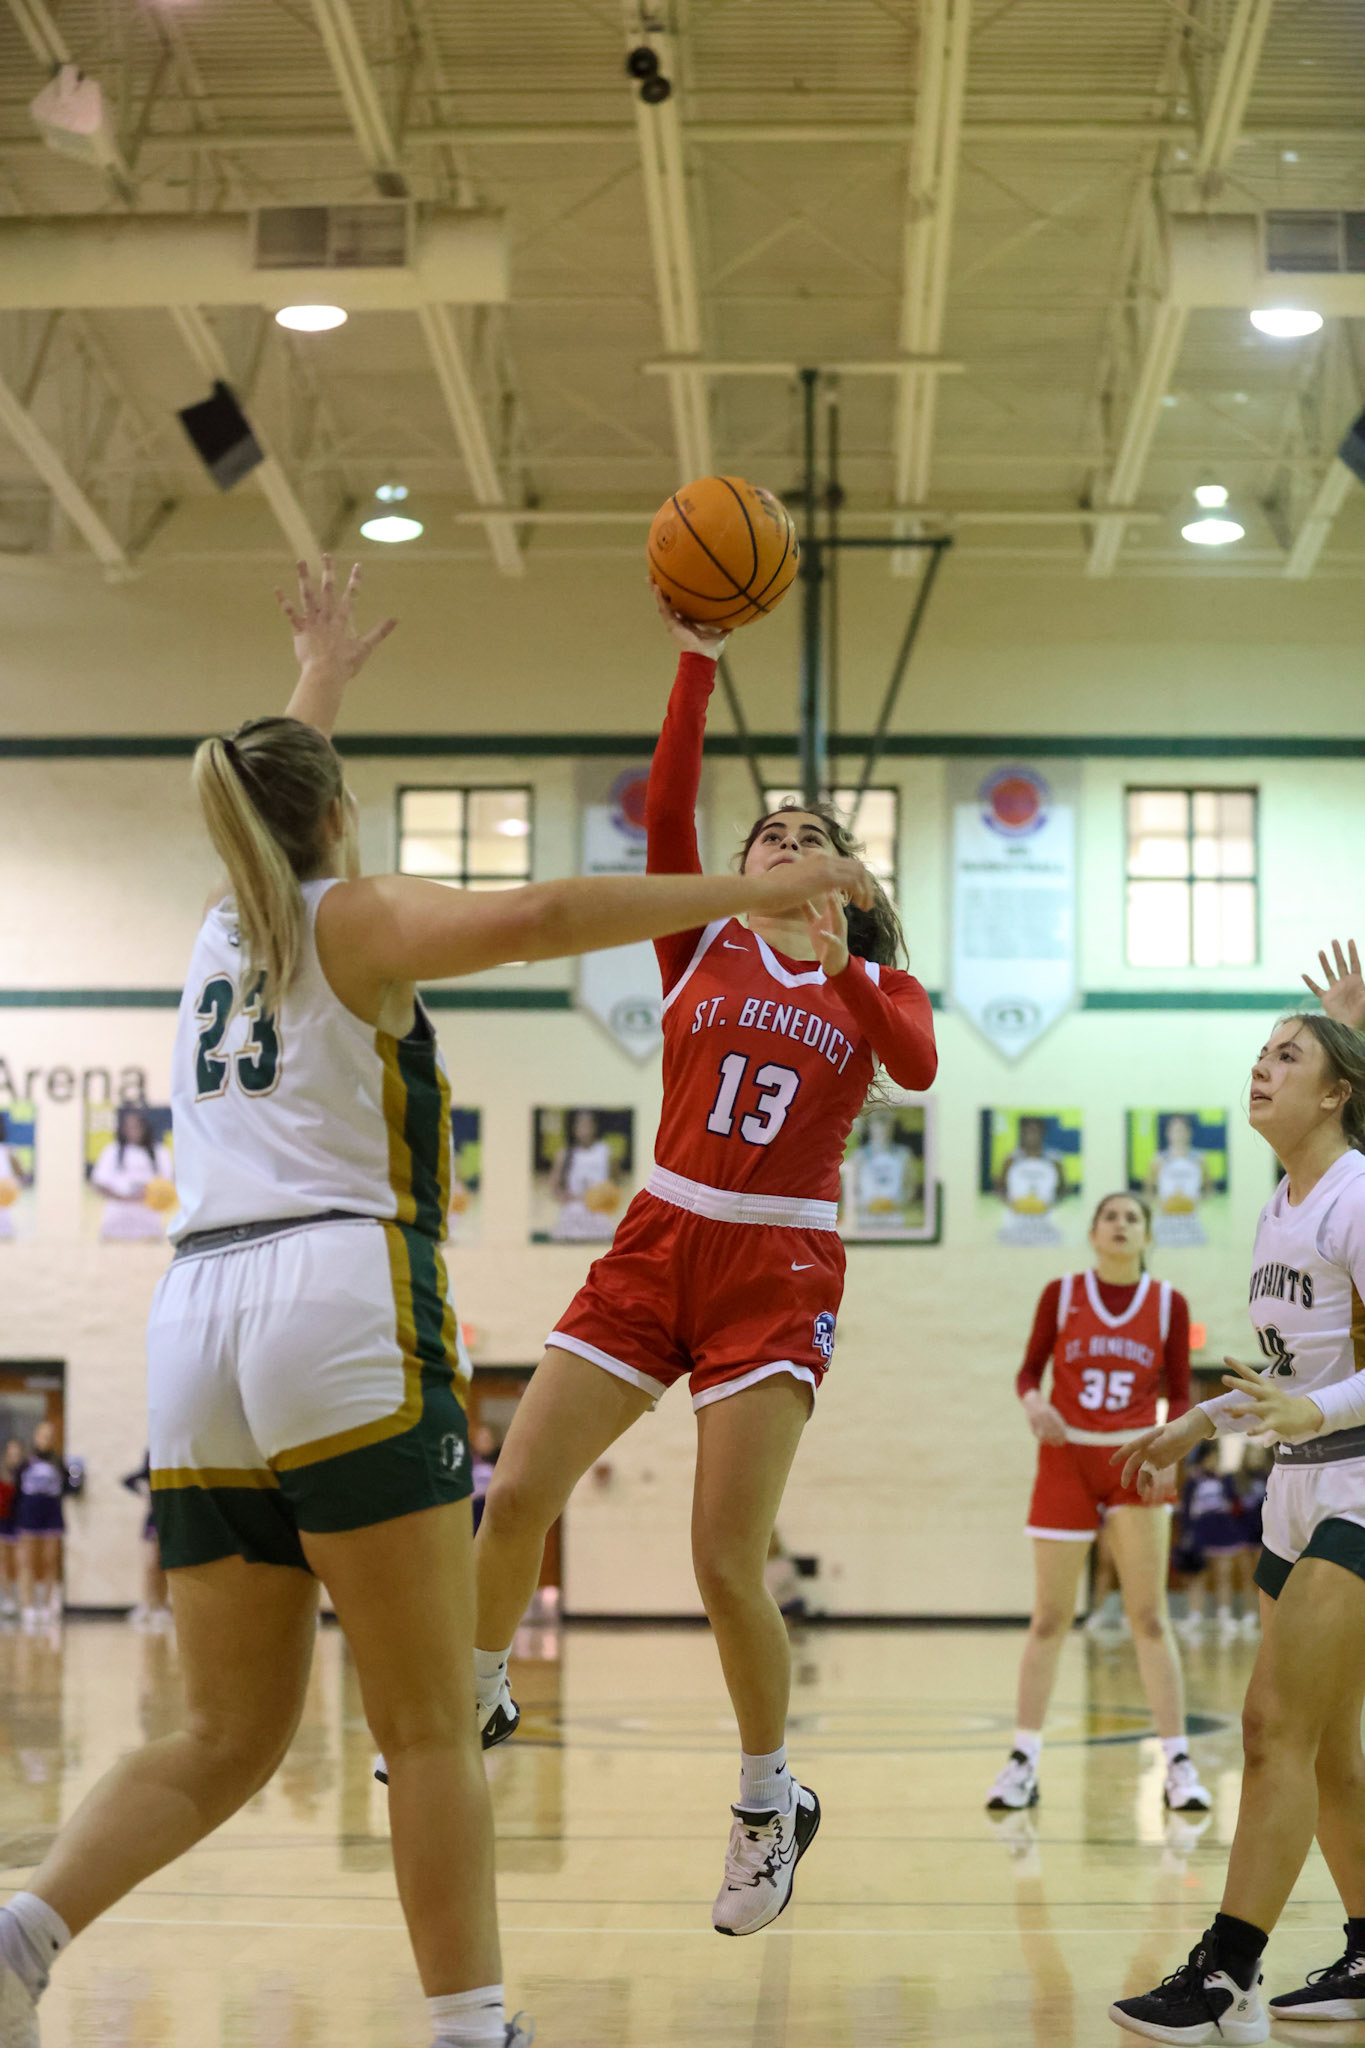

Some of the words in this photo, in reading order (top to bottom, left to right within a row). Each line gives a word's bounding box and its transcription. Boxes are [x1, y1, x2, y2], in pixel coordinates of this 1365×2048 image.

[194, 971, 284, 1103] 23
[691, 996, 727, 1035] ST.
[737, 997, 855, 1076] BENEDICT
[706, 1050, 802, 1147] 13
[1077, 1367, 1136, 1413] 35
